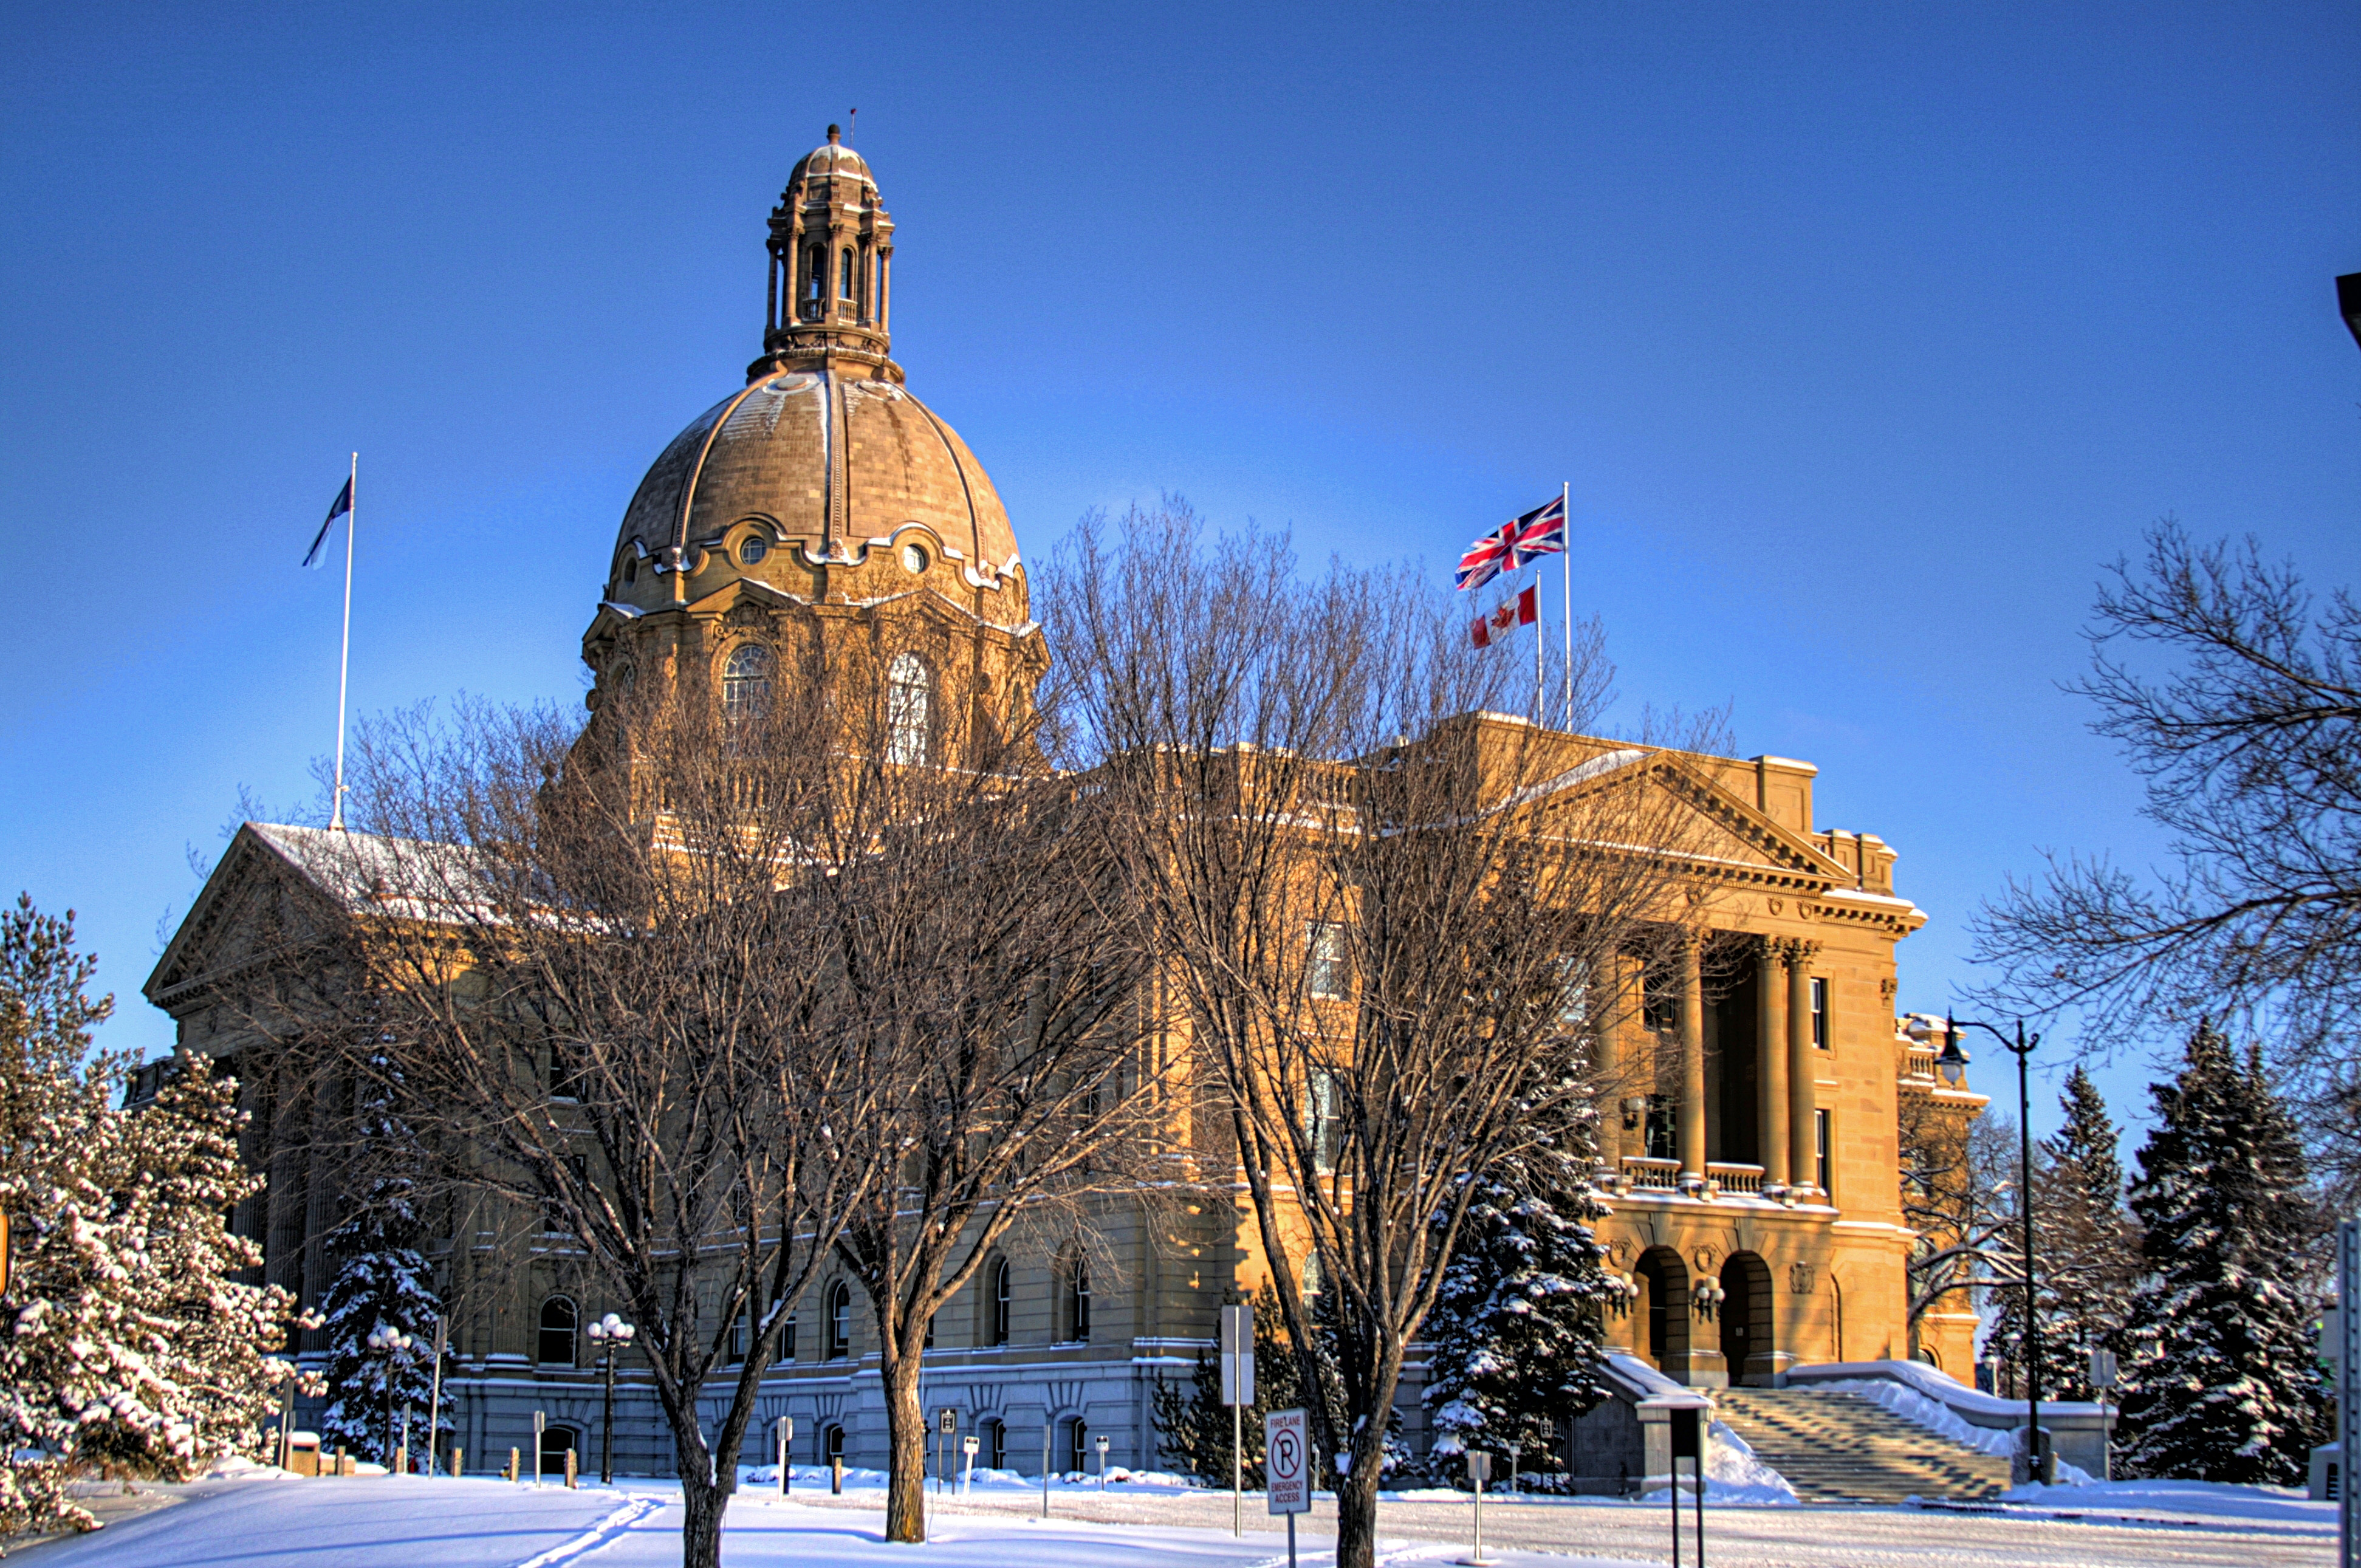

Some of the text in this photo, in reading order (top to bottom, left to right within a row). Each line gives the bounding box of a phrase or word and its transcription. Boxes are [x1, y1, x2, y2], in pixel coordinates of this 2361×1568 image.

[1270, 1416, 1300, 1428] FIRE LANE
[1281, 1439, 1292, 1471] P
[1271, 1480, 1303, 1492] EMERGENCY
[1275, 1491, 1300, 1504] ACCESS
